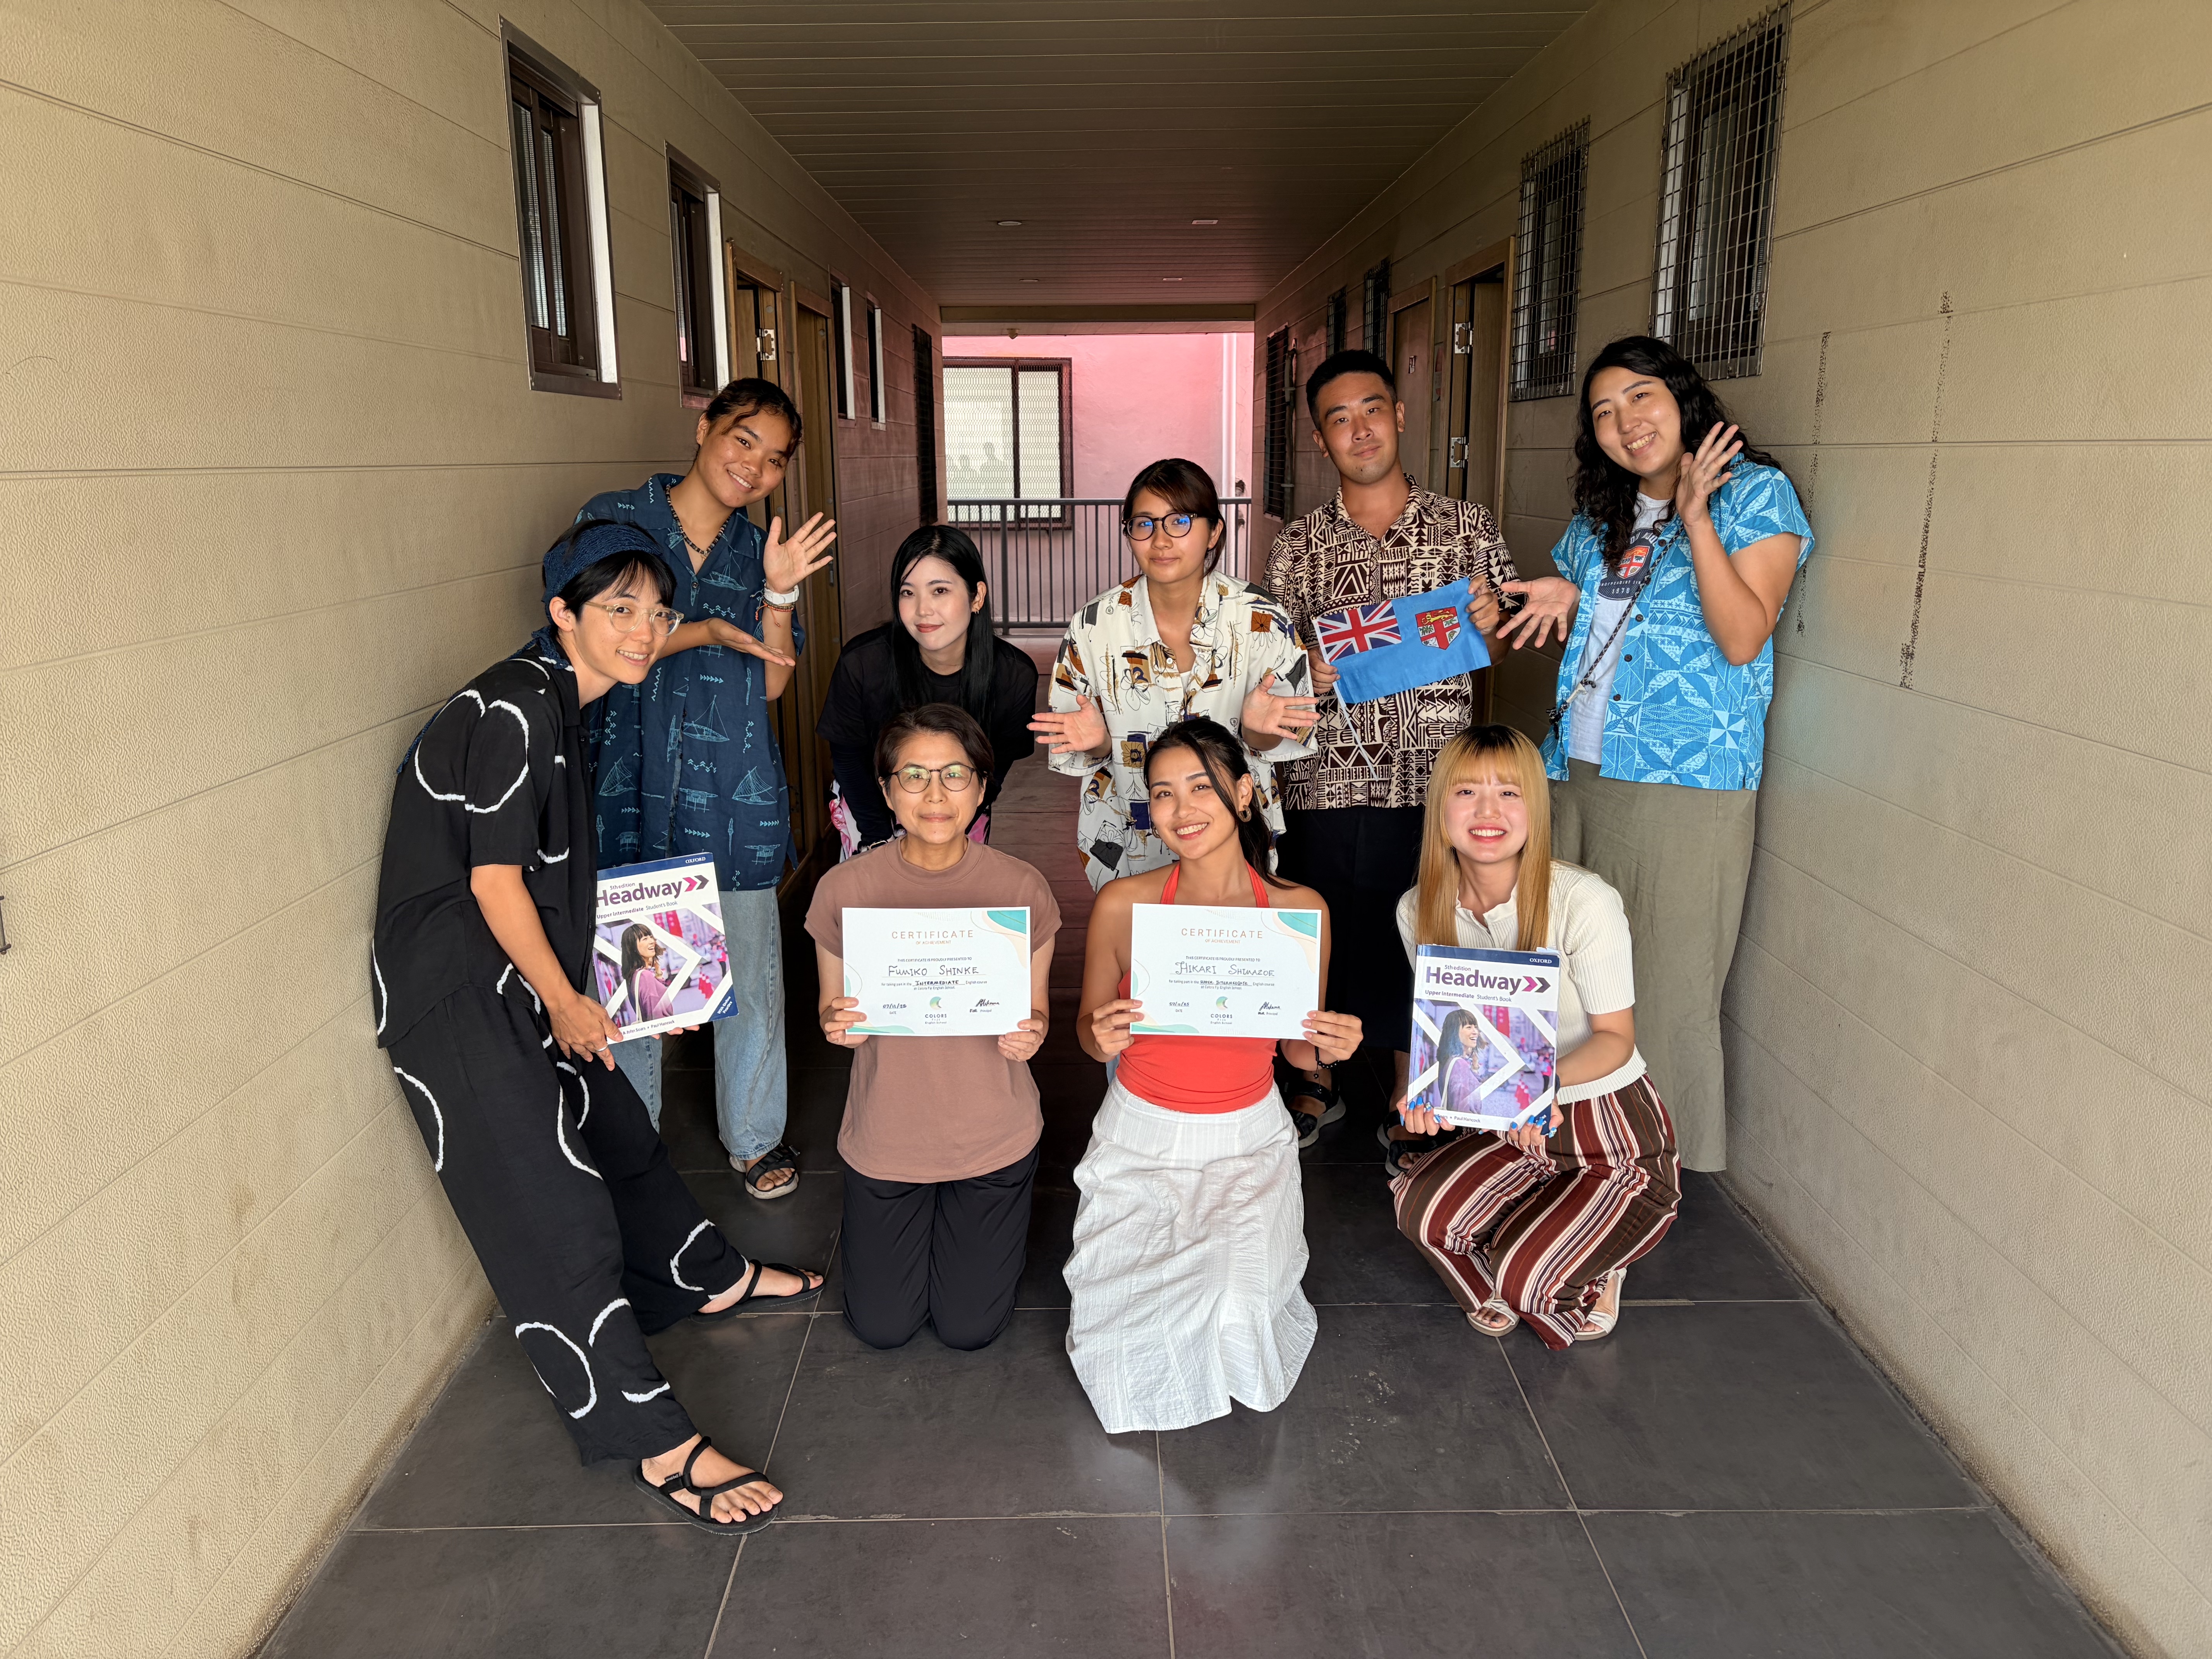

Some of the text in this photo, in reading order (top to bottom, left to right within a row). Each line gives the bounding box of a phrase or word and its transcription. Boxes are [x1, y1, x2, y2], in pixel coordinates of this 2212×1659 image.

[596, 881, 682, 907] Headway
[613, 907, 644, 916] Intermediate
[892, 930, 973, 939] CERTIFICATE
[1182, 928, 1262, 938] CERTIFICATE
[939, 965, 979, 976] SHINKE
[1425, 966, 1522, 996] Headway
